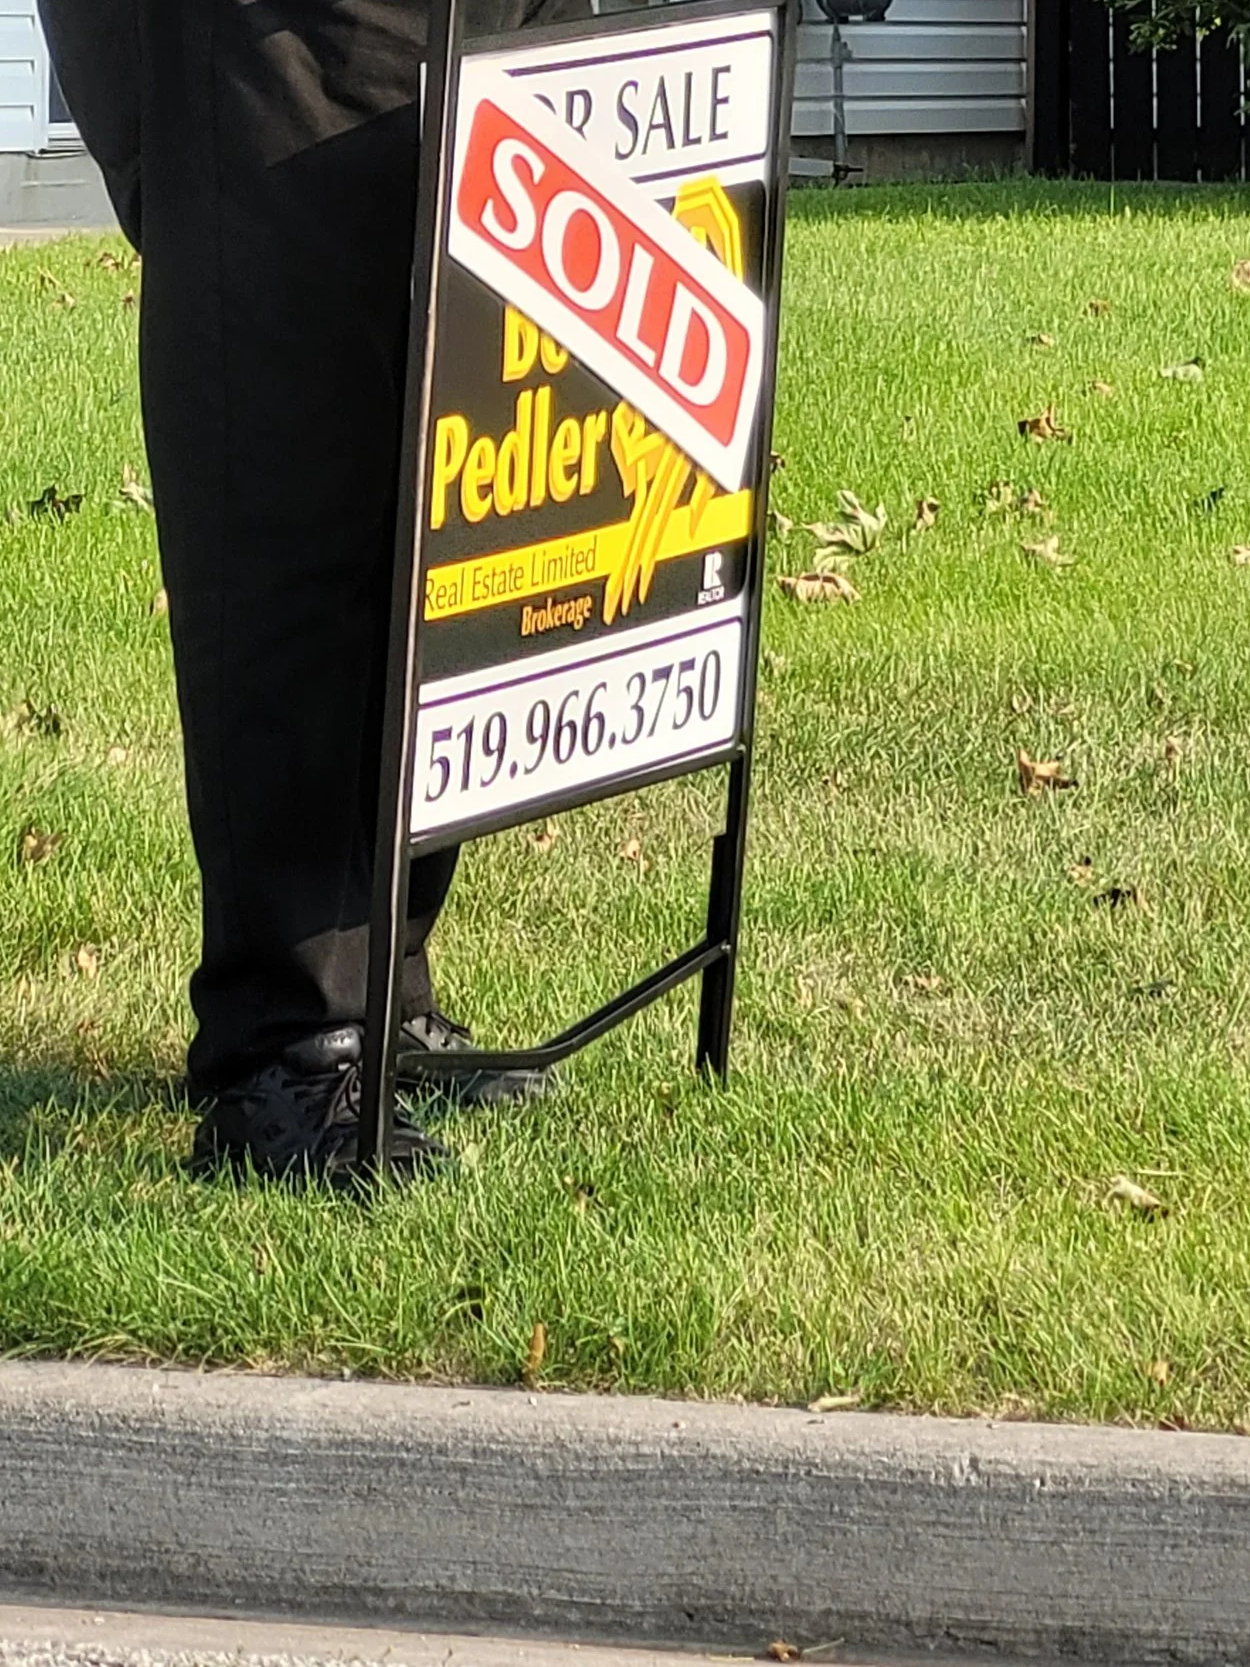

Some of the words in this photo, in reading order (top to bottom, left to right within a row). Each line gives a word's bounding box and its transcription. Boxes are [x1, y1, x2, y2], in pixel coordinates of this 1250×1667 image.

[614, 64, 732, 162] SALE
[479, 137, 728, 407] SOLD
[430, 384, 607, 531] Pedler
[425, 567, 466, 612] Real
[471, 562, 525, 603] Estate
[530, 534, 599, 588] Limited
[520, 595, 593, 637] Brokerage
[423, 649, 722, 804] 519.966.3750
